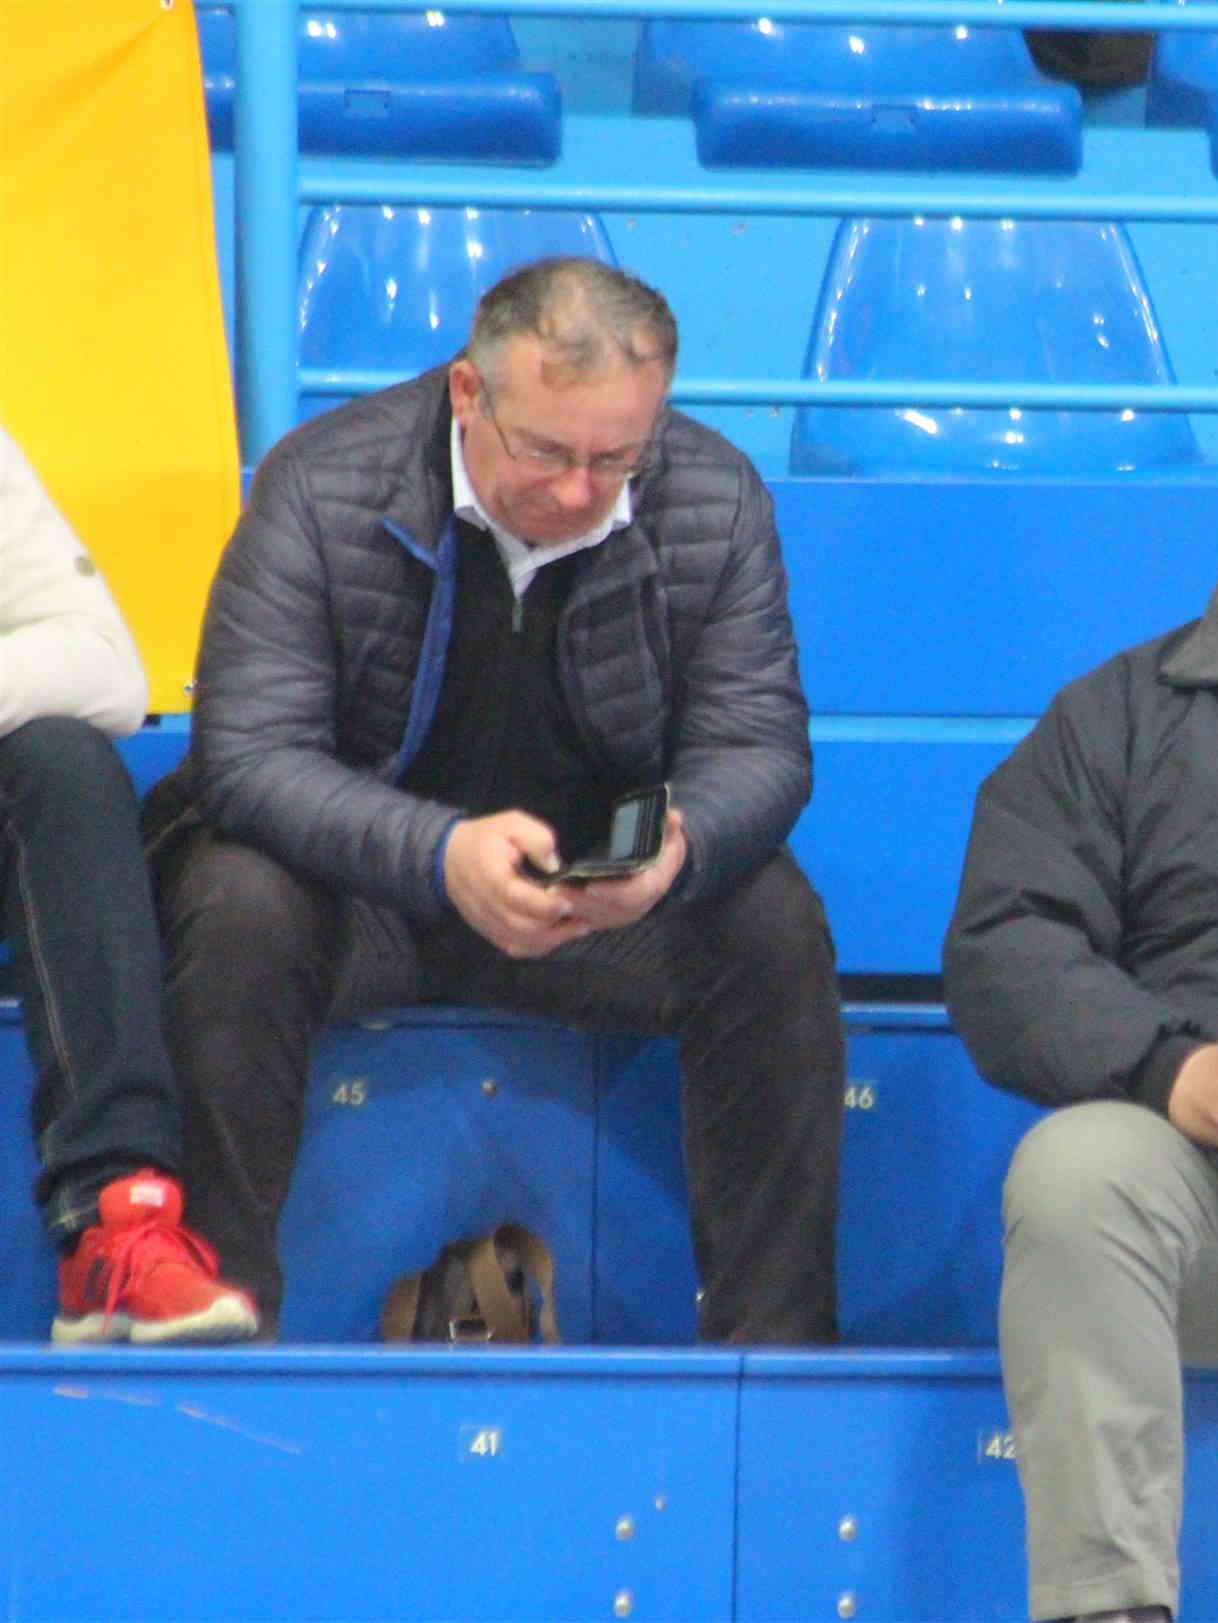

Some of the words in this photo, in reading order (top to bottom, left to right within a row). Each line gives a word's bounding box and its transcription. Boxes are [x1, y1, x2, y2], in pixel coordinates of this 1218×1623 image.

[332, 1082, 366, 1105] 45
[844, 1085, 873, 1109] 46
[470, 1431, 498, 1456] 41
[985, 1432, 1016, 1459] 42
